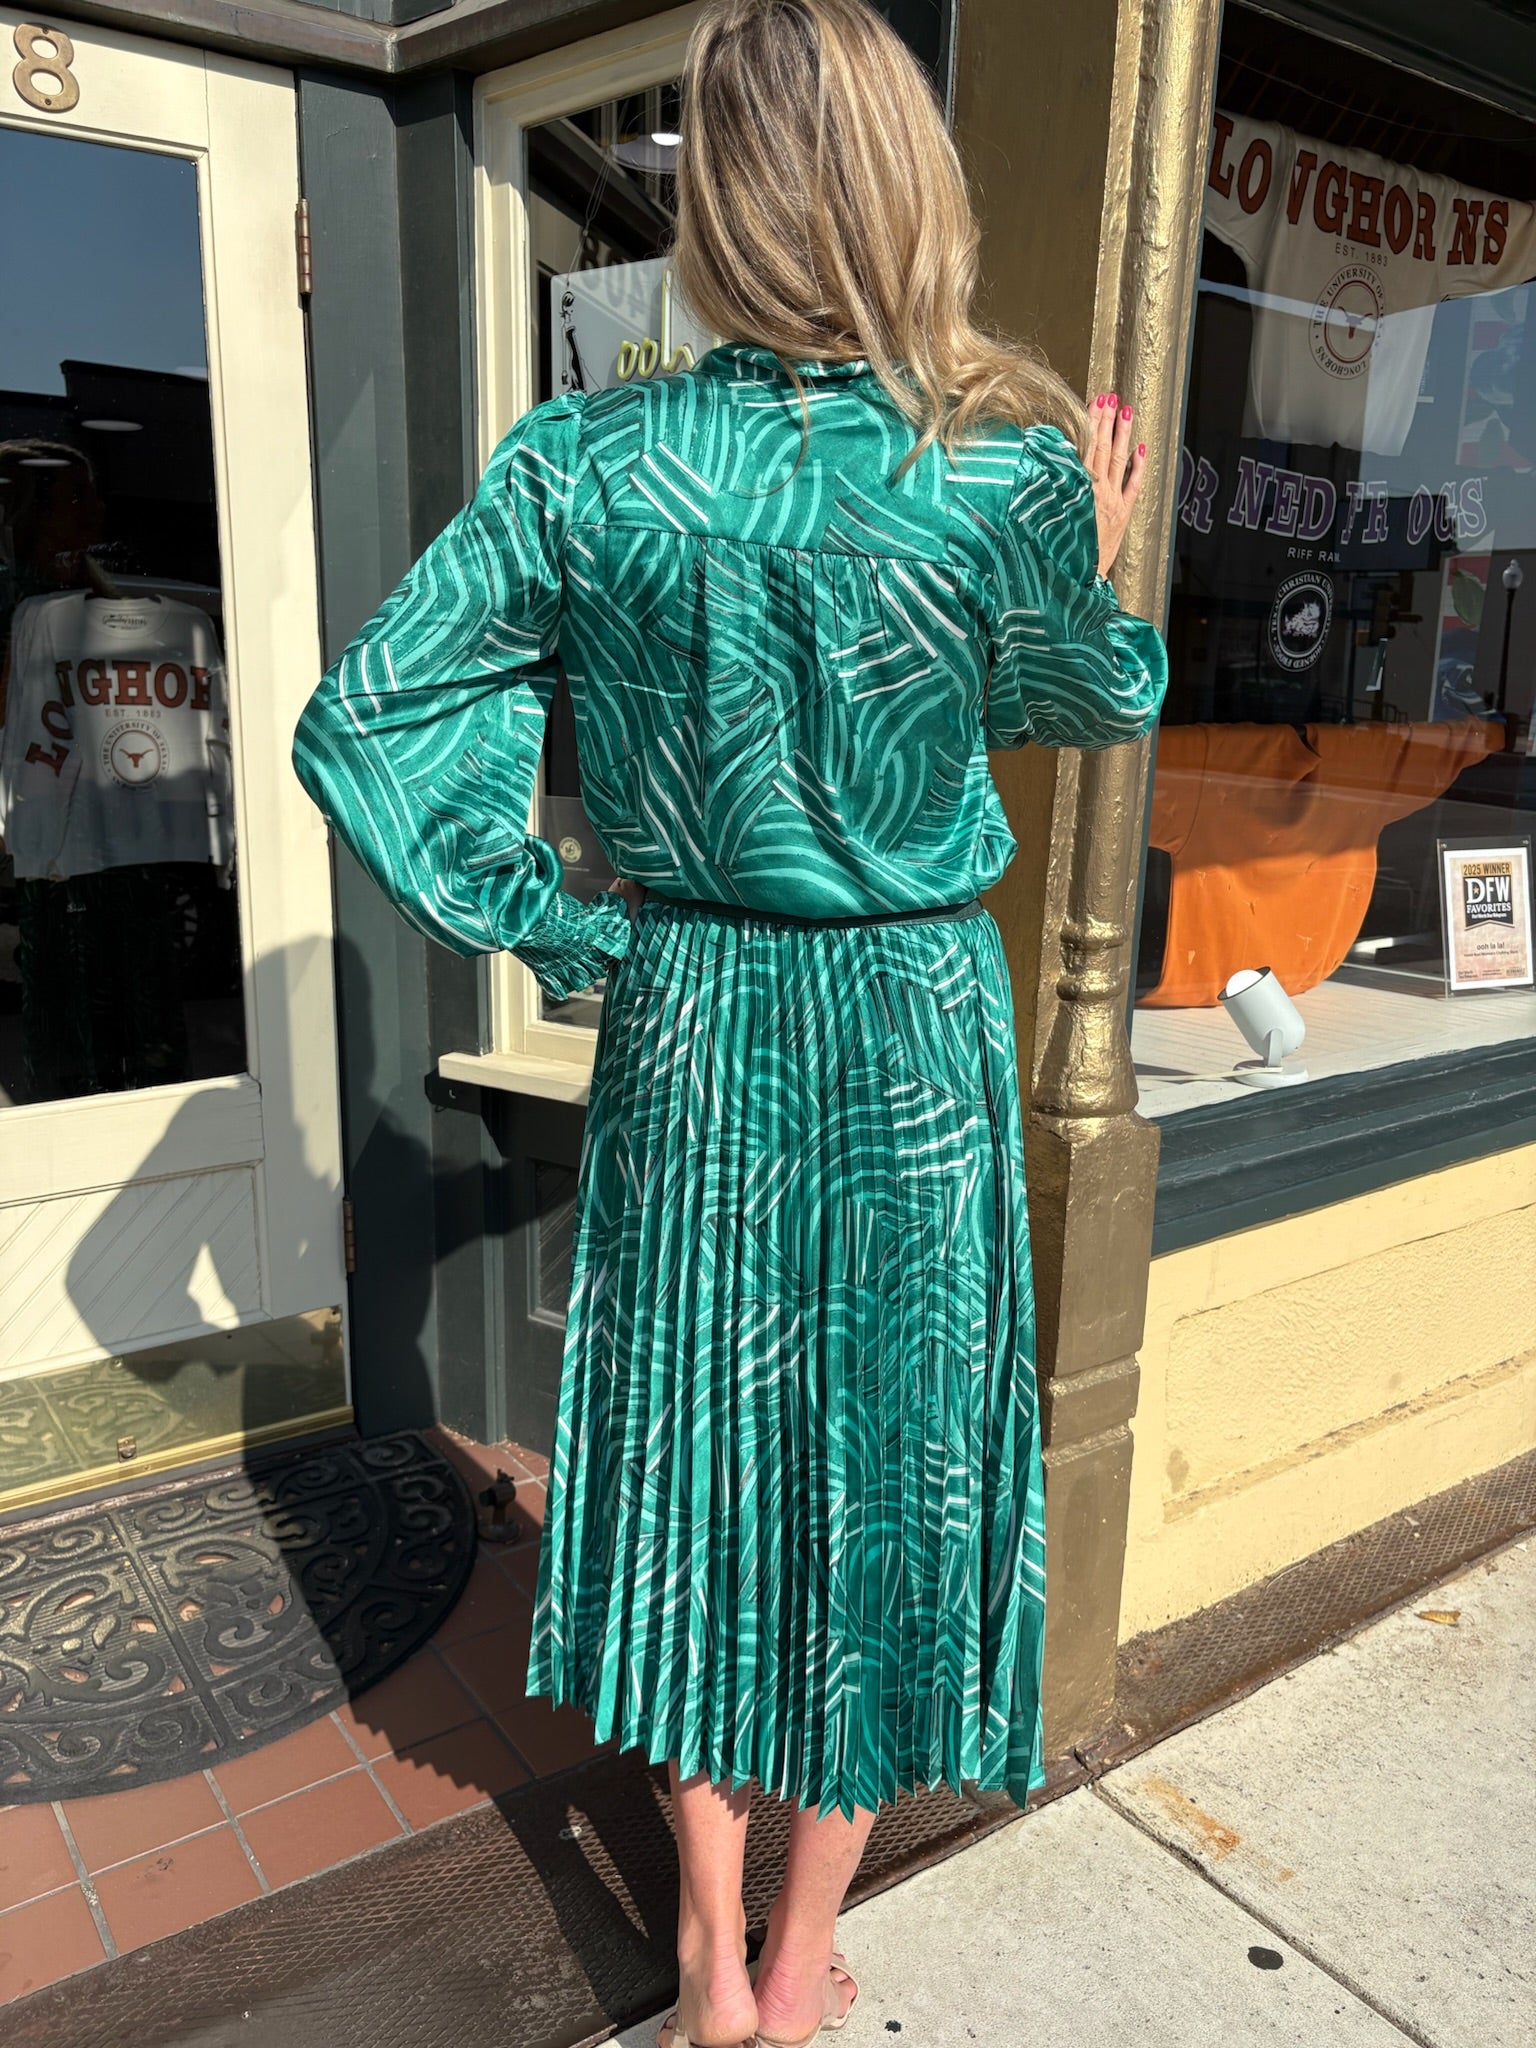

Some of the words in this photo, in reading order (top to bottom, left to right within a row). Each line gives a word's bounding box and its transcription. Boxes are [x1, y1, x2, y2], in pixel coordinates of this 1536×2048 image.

[13, 23, 80, 113] 8
[1335, 242, 1360, 260] EST.
[1365, 251, 1389, 267] 1883
[1326, 268, 1377, 297] UNIVERSITY
[1315, 346, 1367, 377] LONGHORNS
[1286, 546, 1313, 560] RIFF
[1277, 573, 1322, 598] CHRISTIAN
[1463, 864, 1482, 876] 2025
[1483, 862, 1511, 875] WINNER
[1465, 876, 1511, 904] DFW
[1466, 902, 1512, 914] FAVORITES
[1476, 941, 1489, 951] ooh
